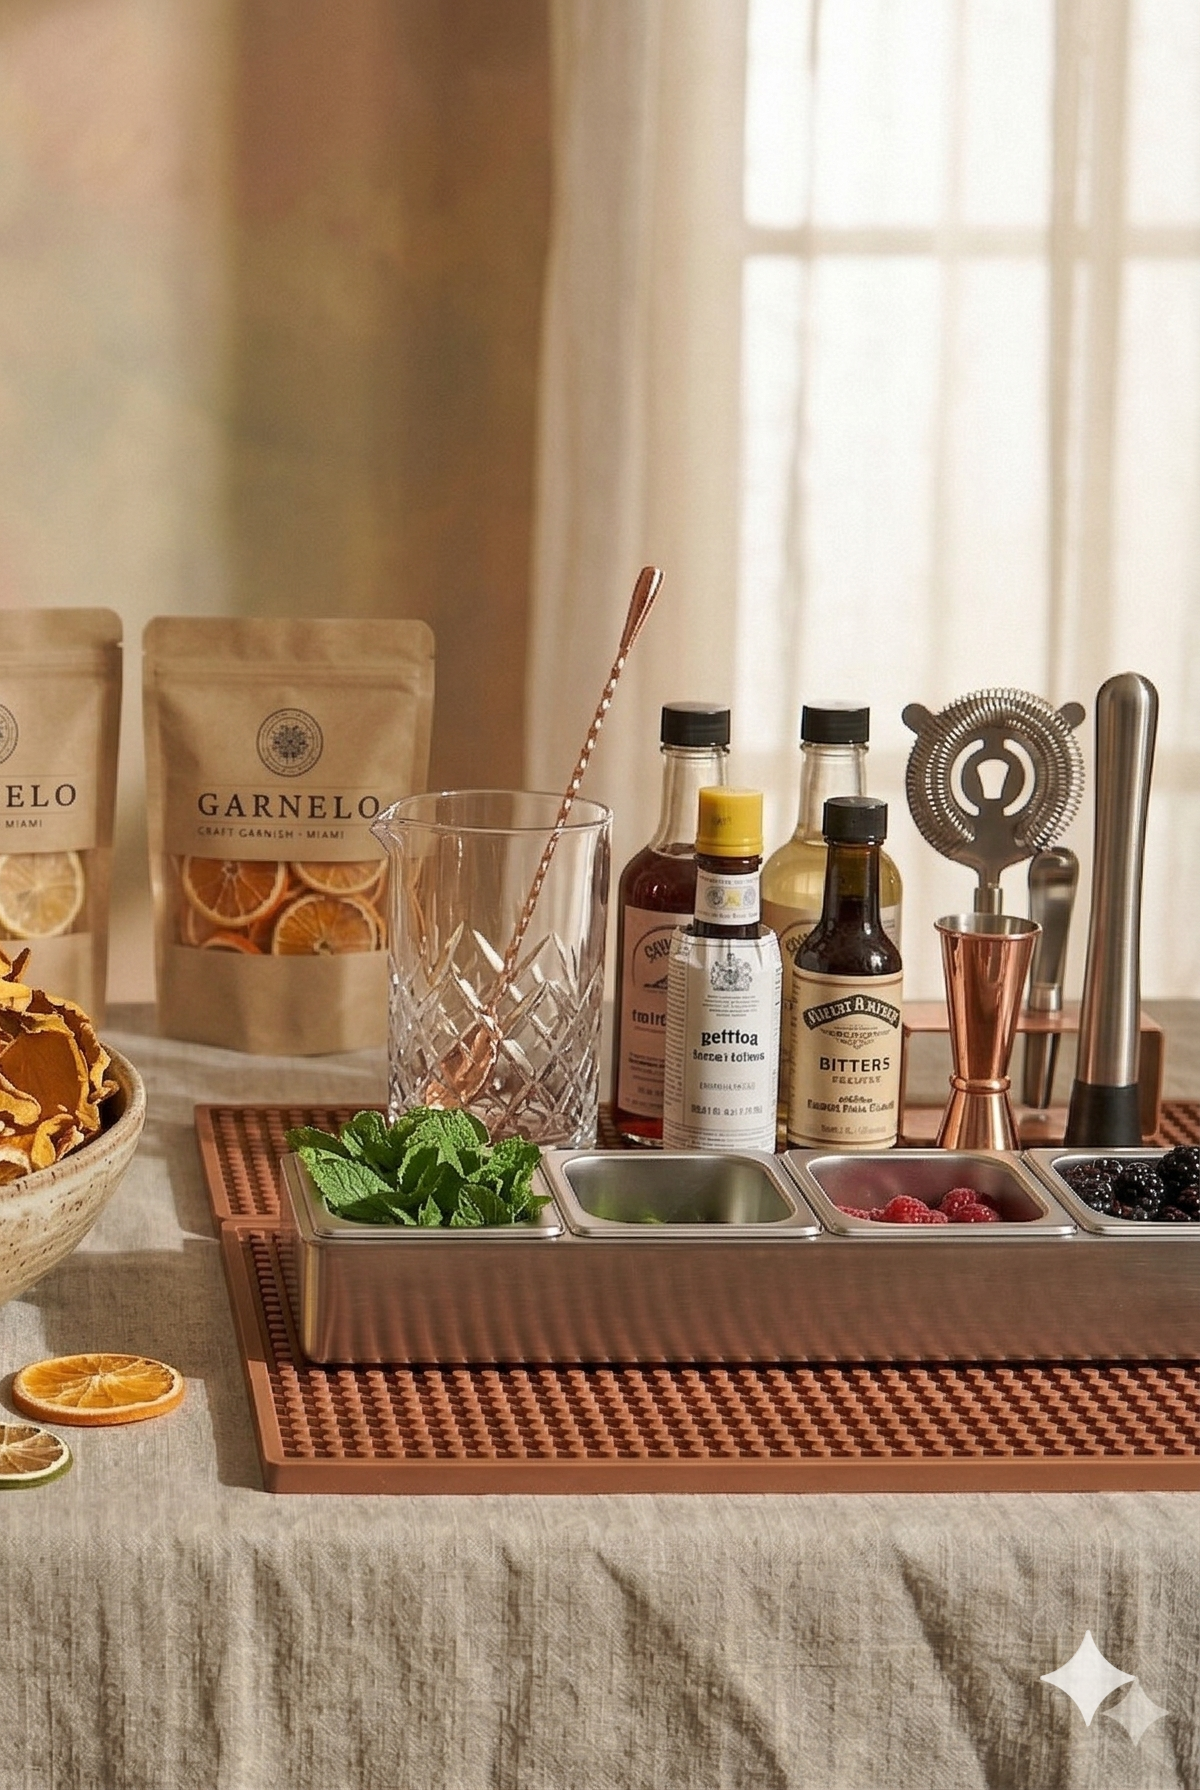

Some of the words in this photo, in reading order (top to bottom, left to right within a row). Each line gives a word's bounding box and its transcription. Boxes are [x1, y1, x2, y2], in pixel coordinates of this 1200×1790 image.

[197, 792, 380, 820] GARNELO
[5, 819, 43, 829] MIAMI
[197, 825, 235, 837] CRAFT
[238, 827, 294, 839] GARNISH
[306, 829, 345, 840] MIAMI
[819, 1056, 890, 1073] BITTERS
